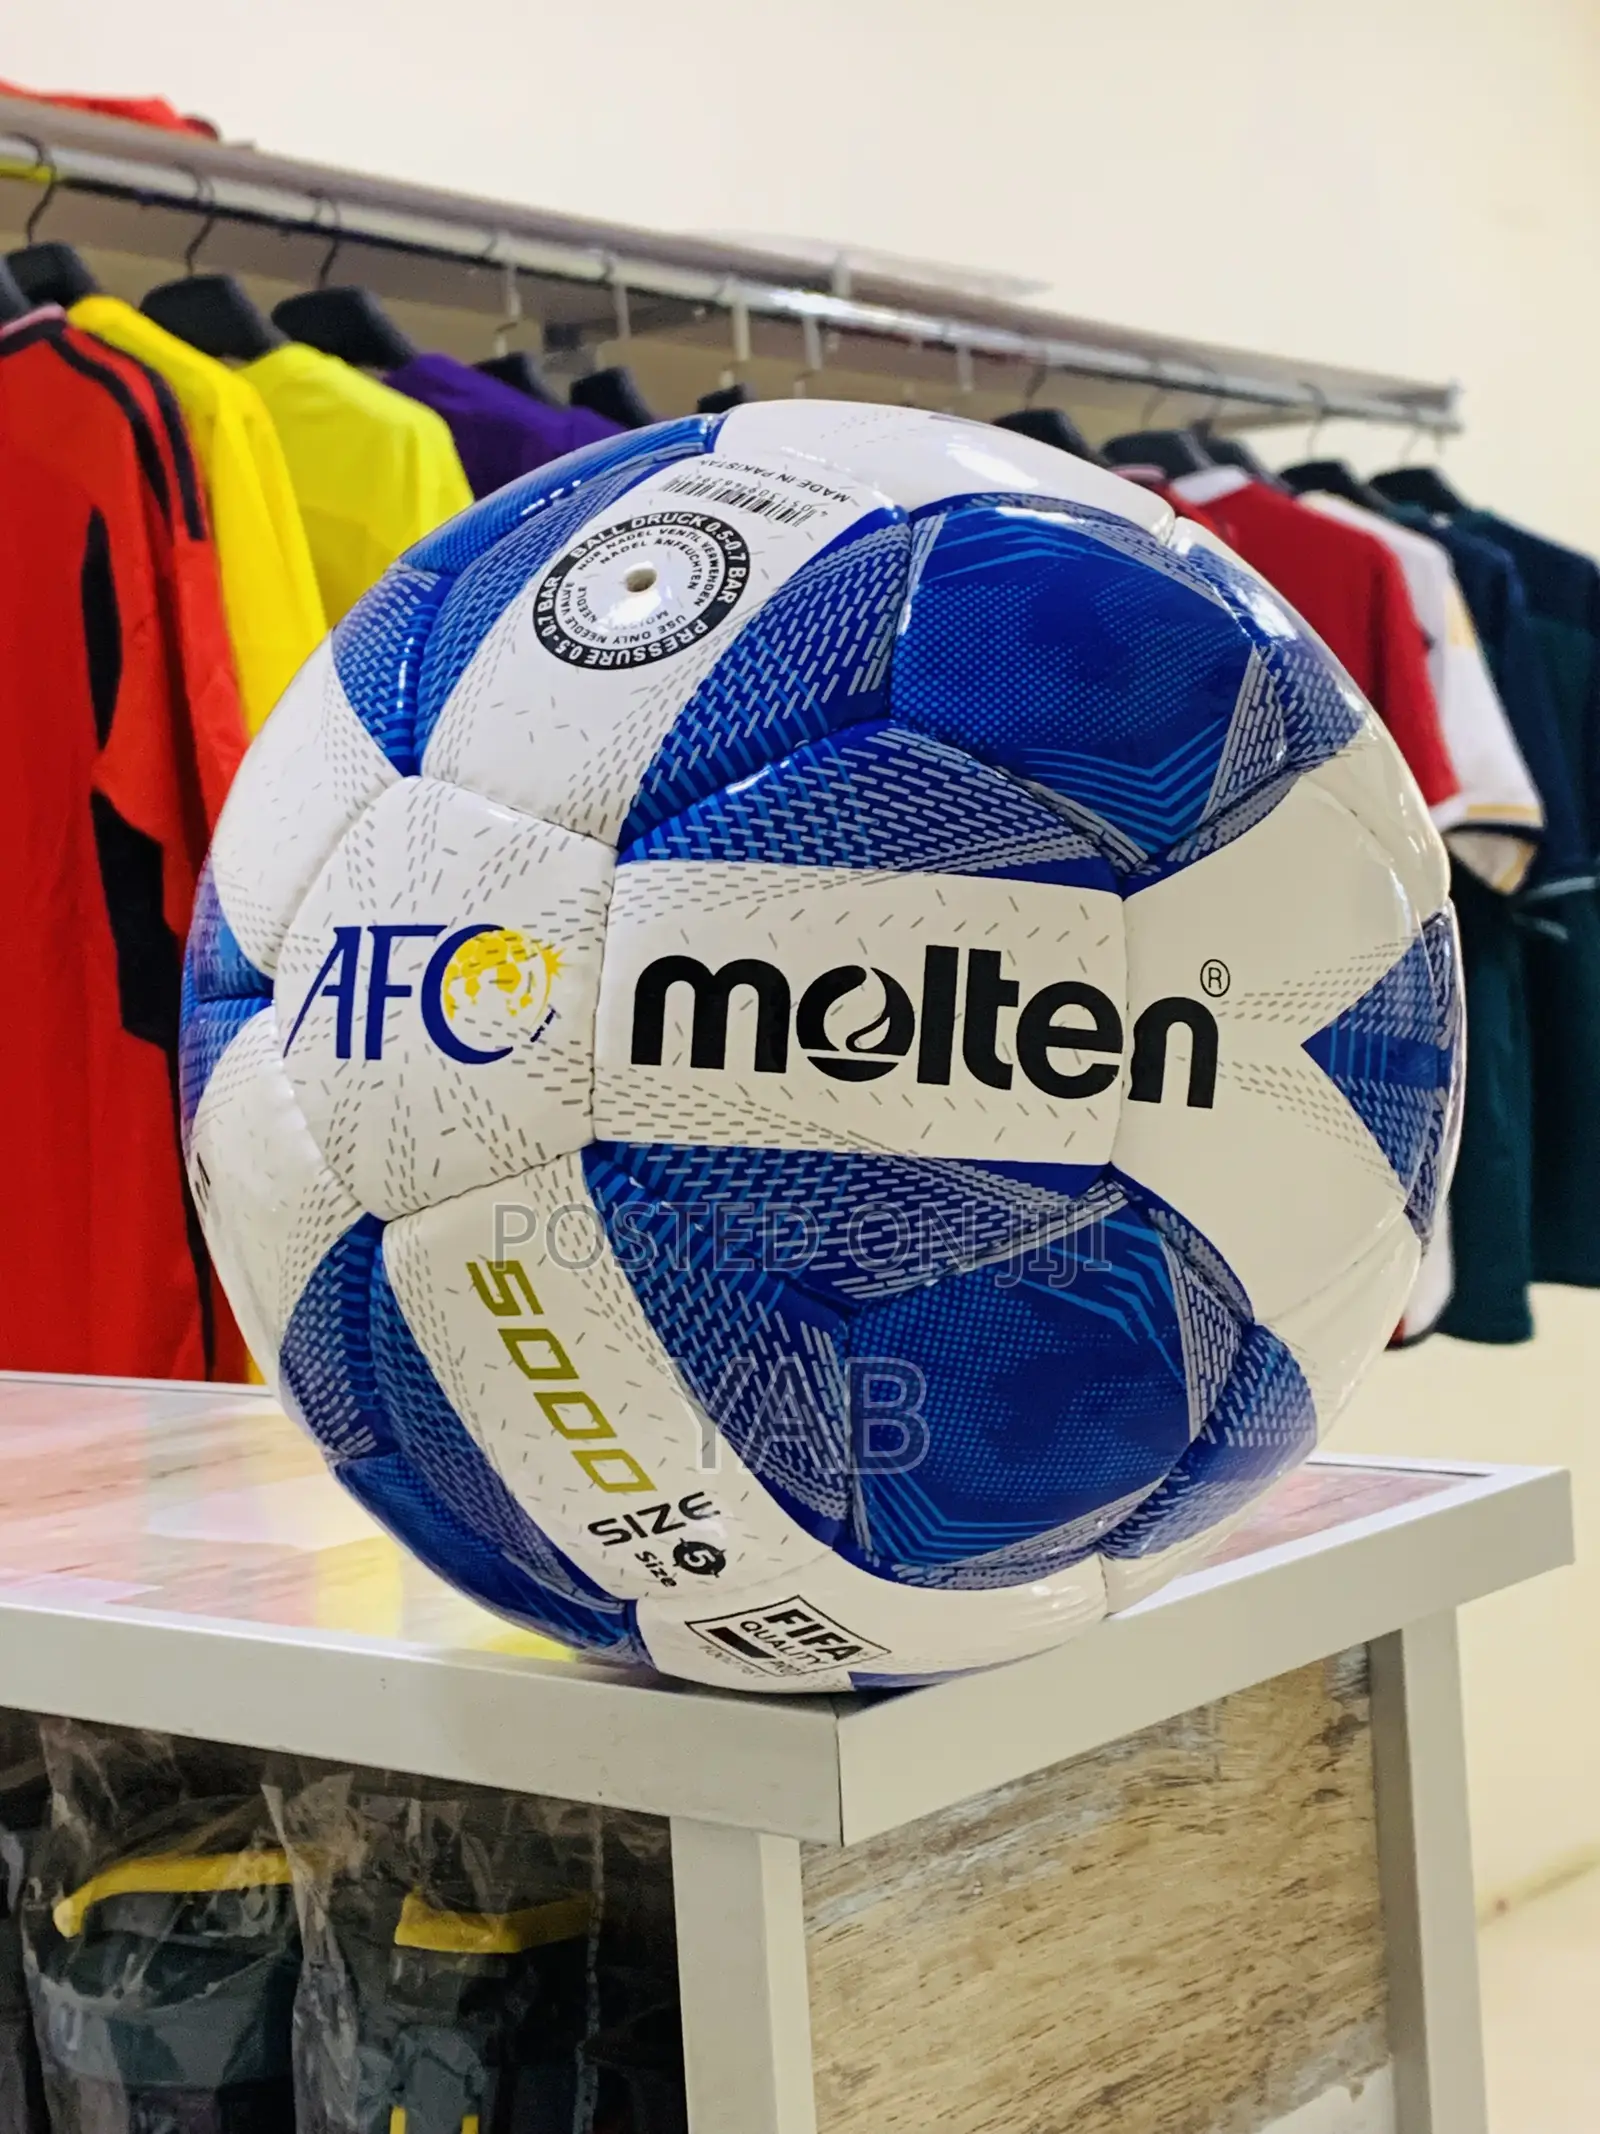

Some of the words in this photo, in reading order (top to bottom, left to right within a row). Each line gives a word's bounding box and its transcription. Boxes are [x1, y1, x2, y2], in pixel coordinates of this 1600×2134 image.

[776, 473, 797, 484] IN
[799, 479, 852, 503] MADE
[607, 530, 652, 549] NADEL
[630, 512, 708, 529] DRUCK
[569, 526, 625, 559] BALL
[704, 521, 747, 562] 0.5-0.7
[654, 538, 703, 590] ANFEUCHTEN
[536, 575, 563, 613] BAR
[716, 565, 748, 605] BAR
[576, 586, 599, 624] NEEDLE
[657, 614, 688, 634] USE
[565, 615, 608, 644] NEEDLE
[583, 618, 709, 667] PRESSURE
[612, 630, 652, 645] ONLY
[283, 924, 514, 1065] AFC
[631, 945, 1219, 1109] molten
[465, 1260, 659, 1494] 5000
[587, 1491, 721, 1547] SIZE
[739, 1620, 828, 1665] QUALITY
[763, 1608, 864, 1661] FIFA
